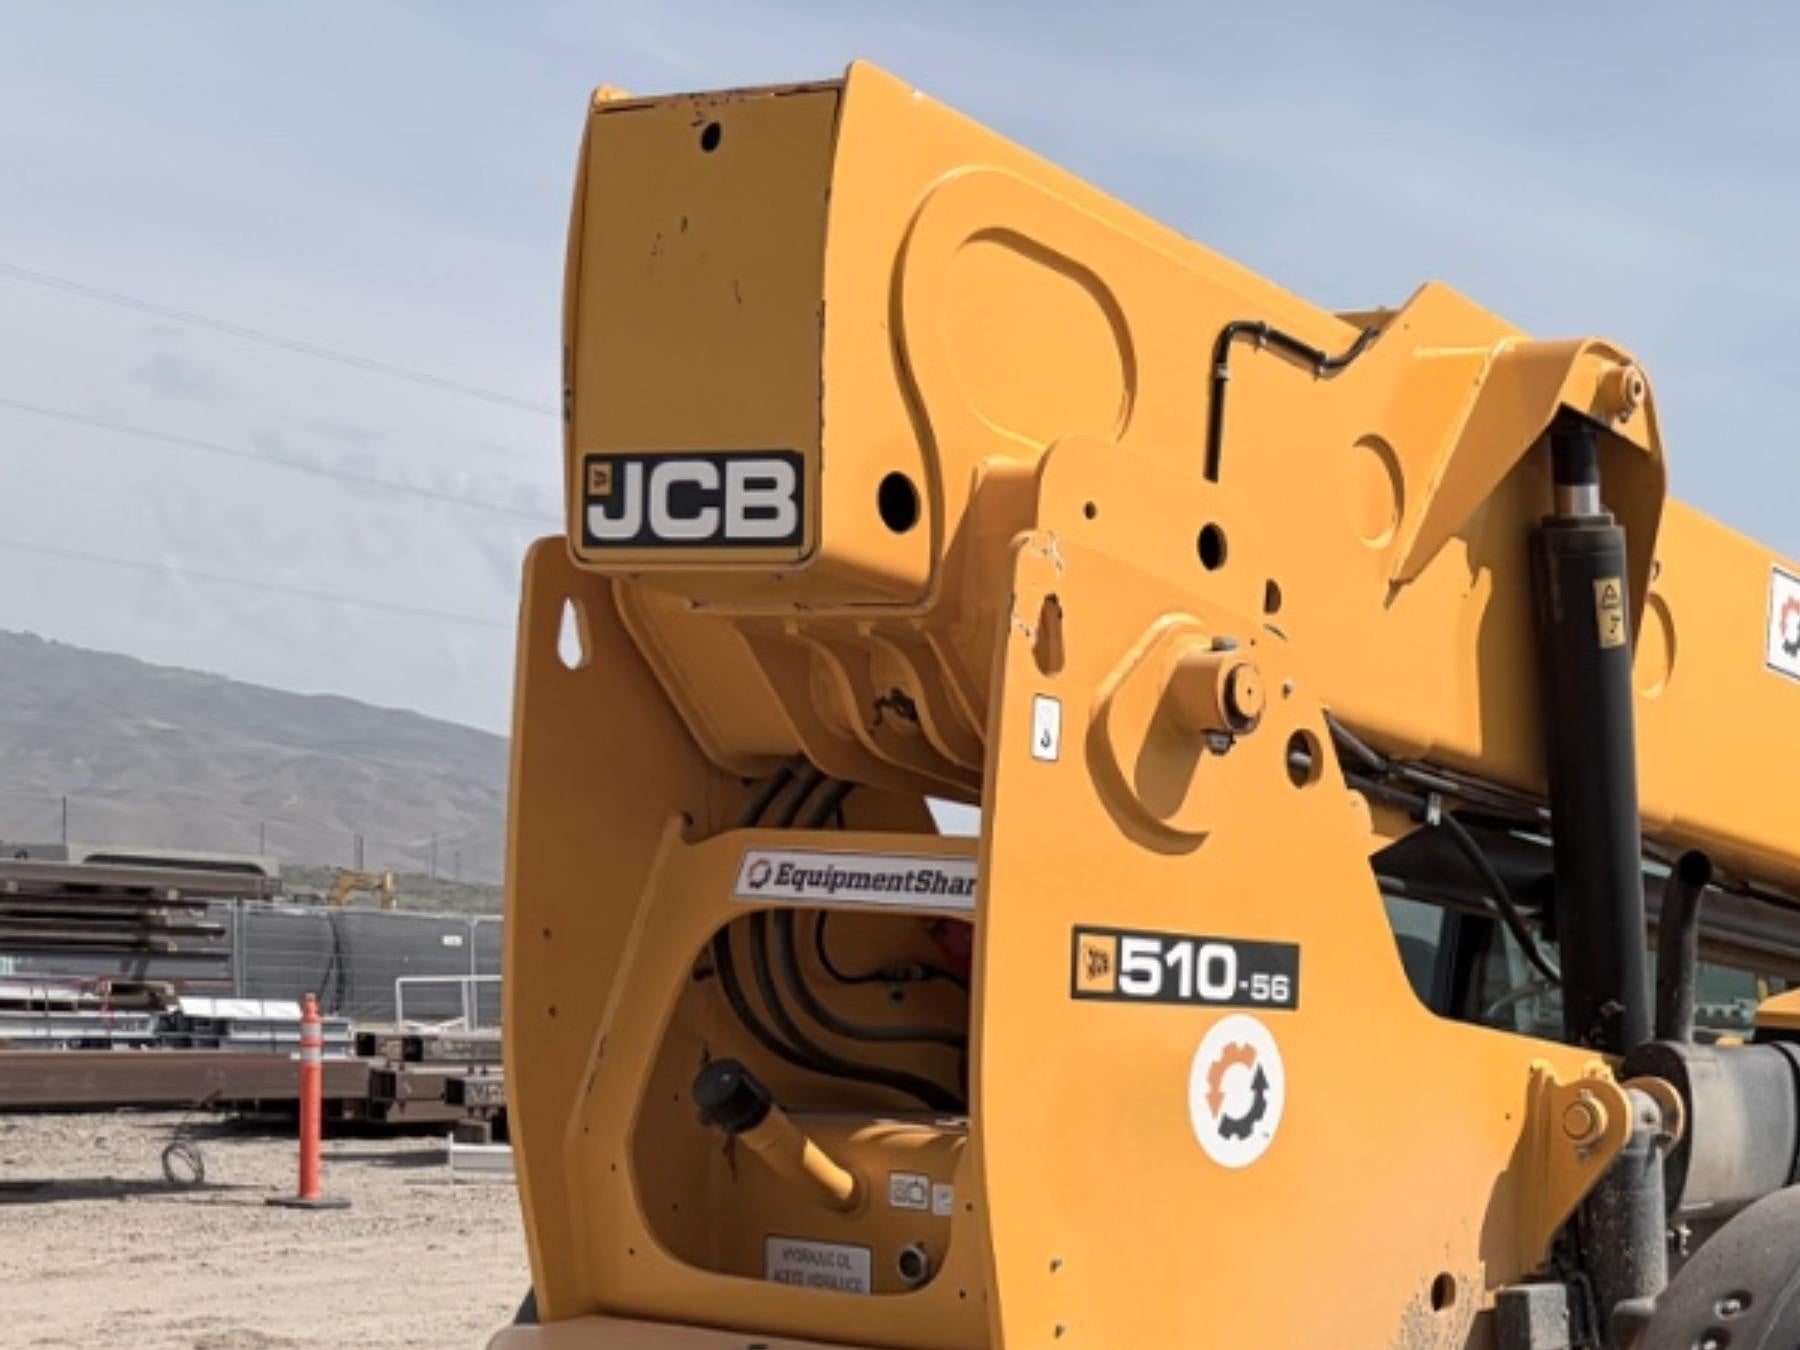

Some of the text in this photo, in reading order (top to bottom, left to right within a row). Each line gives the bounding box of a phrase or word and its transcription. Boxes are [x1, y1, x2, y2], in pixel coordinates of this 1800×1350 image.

[588, 459, 797, 540] JCB
[773, 862, 977, 896] EquipmentShar
[1119, 936, 1290, 1002] 510-56
